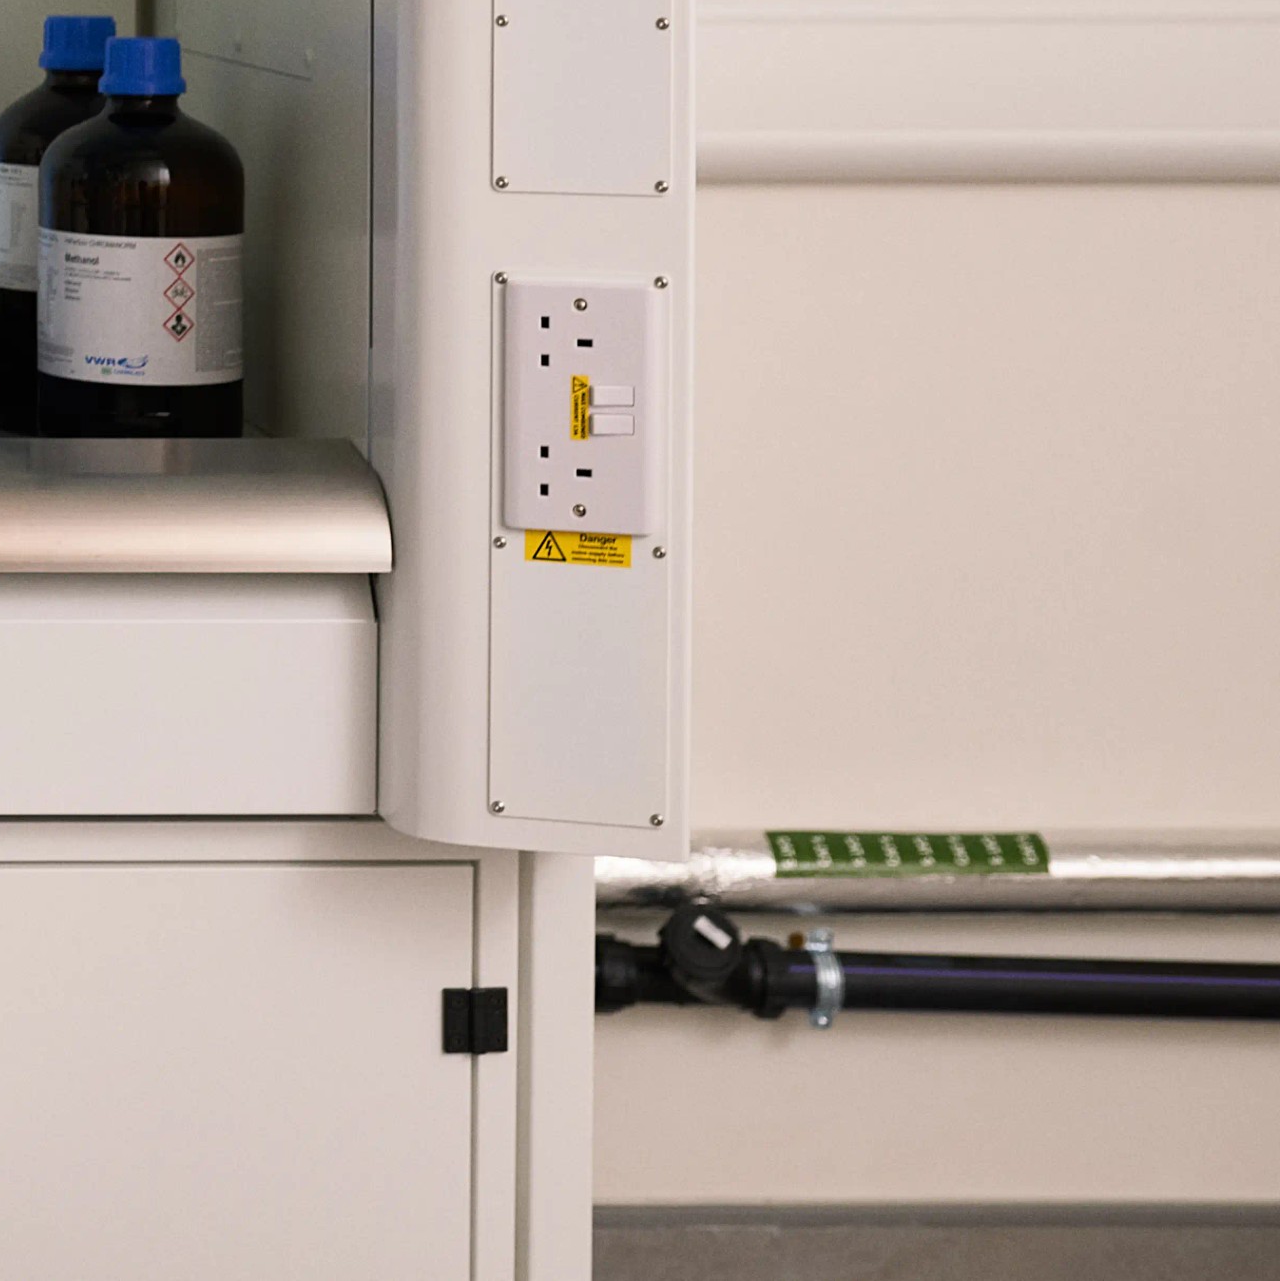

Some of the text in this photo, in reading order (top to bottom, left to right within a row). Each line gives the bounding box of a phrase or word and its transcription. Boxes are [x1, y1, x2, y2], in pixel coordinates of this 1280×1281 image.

[65, 253, 99, 266] Methanol
[85, 356, 115, 366] VWR
[580, 533, 617, 544] Danger
